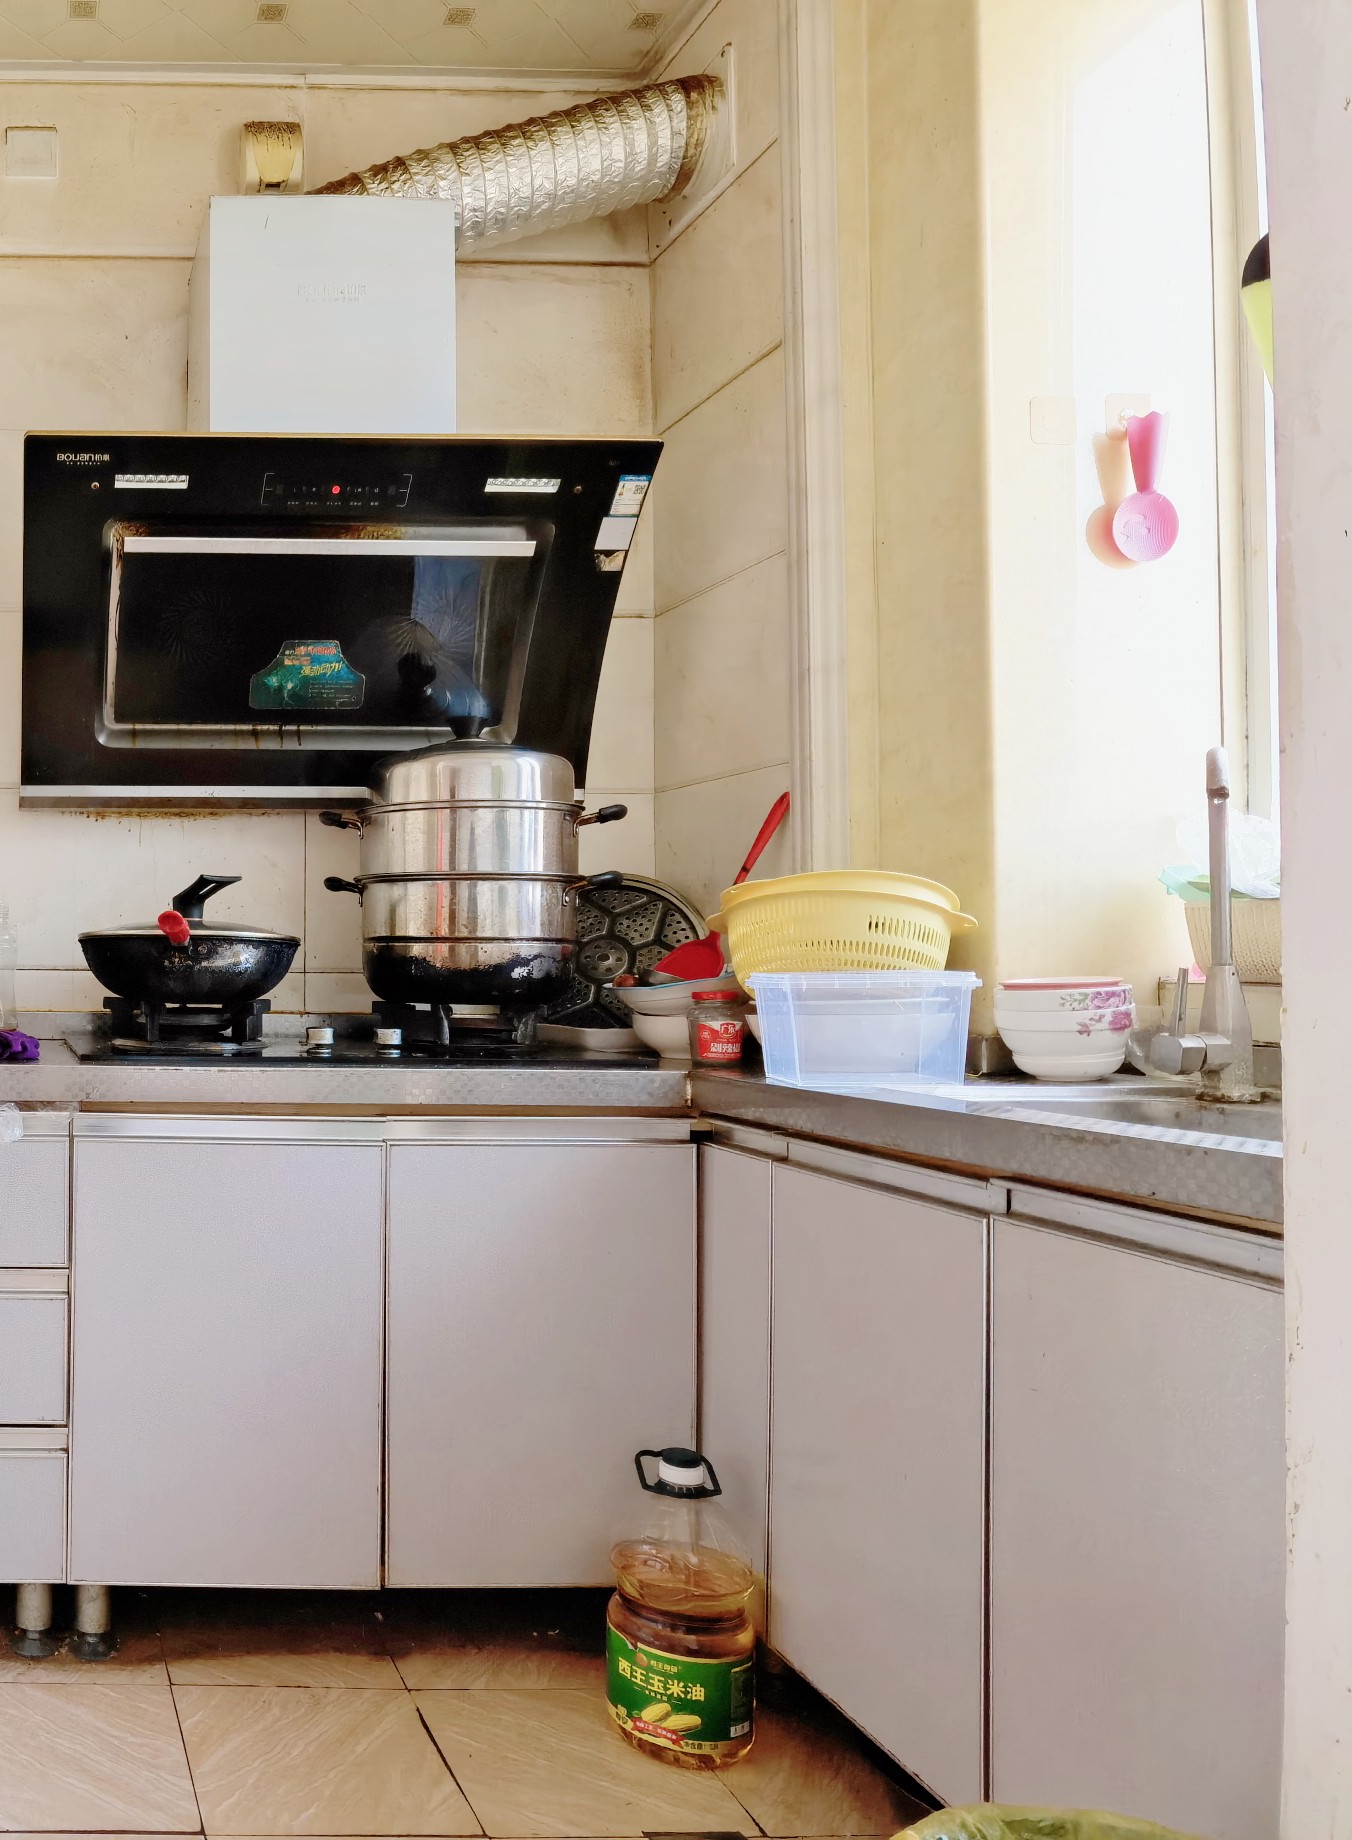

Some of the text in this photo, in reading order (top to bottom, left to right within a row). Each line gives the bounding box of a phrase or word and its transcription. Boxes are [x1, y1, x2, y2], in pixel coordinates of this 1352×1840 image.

[618, 1656, 705, 1701] 西王玉米油
